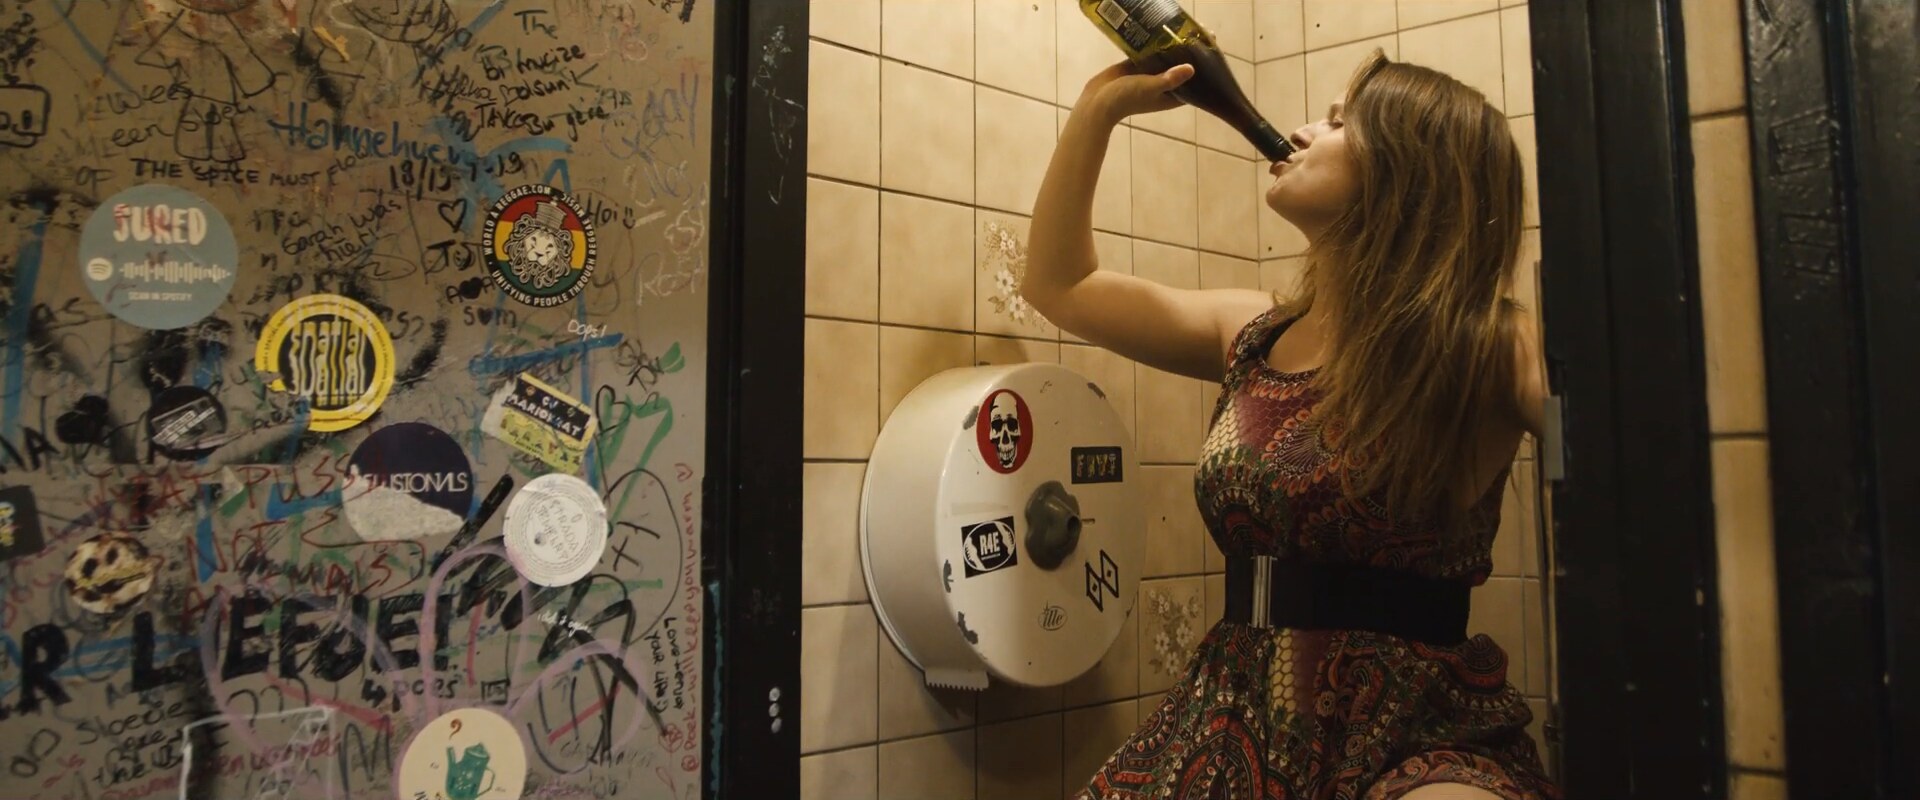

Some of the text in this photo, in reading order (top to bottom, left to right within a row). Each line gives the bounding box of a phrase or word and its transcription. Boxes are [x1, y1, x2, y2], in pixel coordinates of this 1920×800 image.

[514, 9, 559, 40] The
[130, 157, 184, 180] THE
[270, 170, 323, 187] MUST
[483, 184, 553, 257] WORLD A REGGAE.COM
[582, 217, 597, 256] REGGAE
[490, 269, 531, 304] UNIFYING
[568, 257, 597, 298] THROUGH
[532, 291, 569, 307] PEOPLE
[567, 318, 609, 346] Oops!
[979, 530, 1001, 556] R4E
